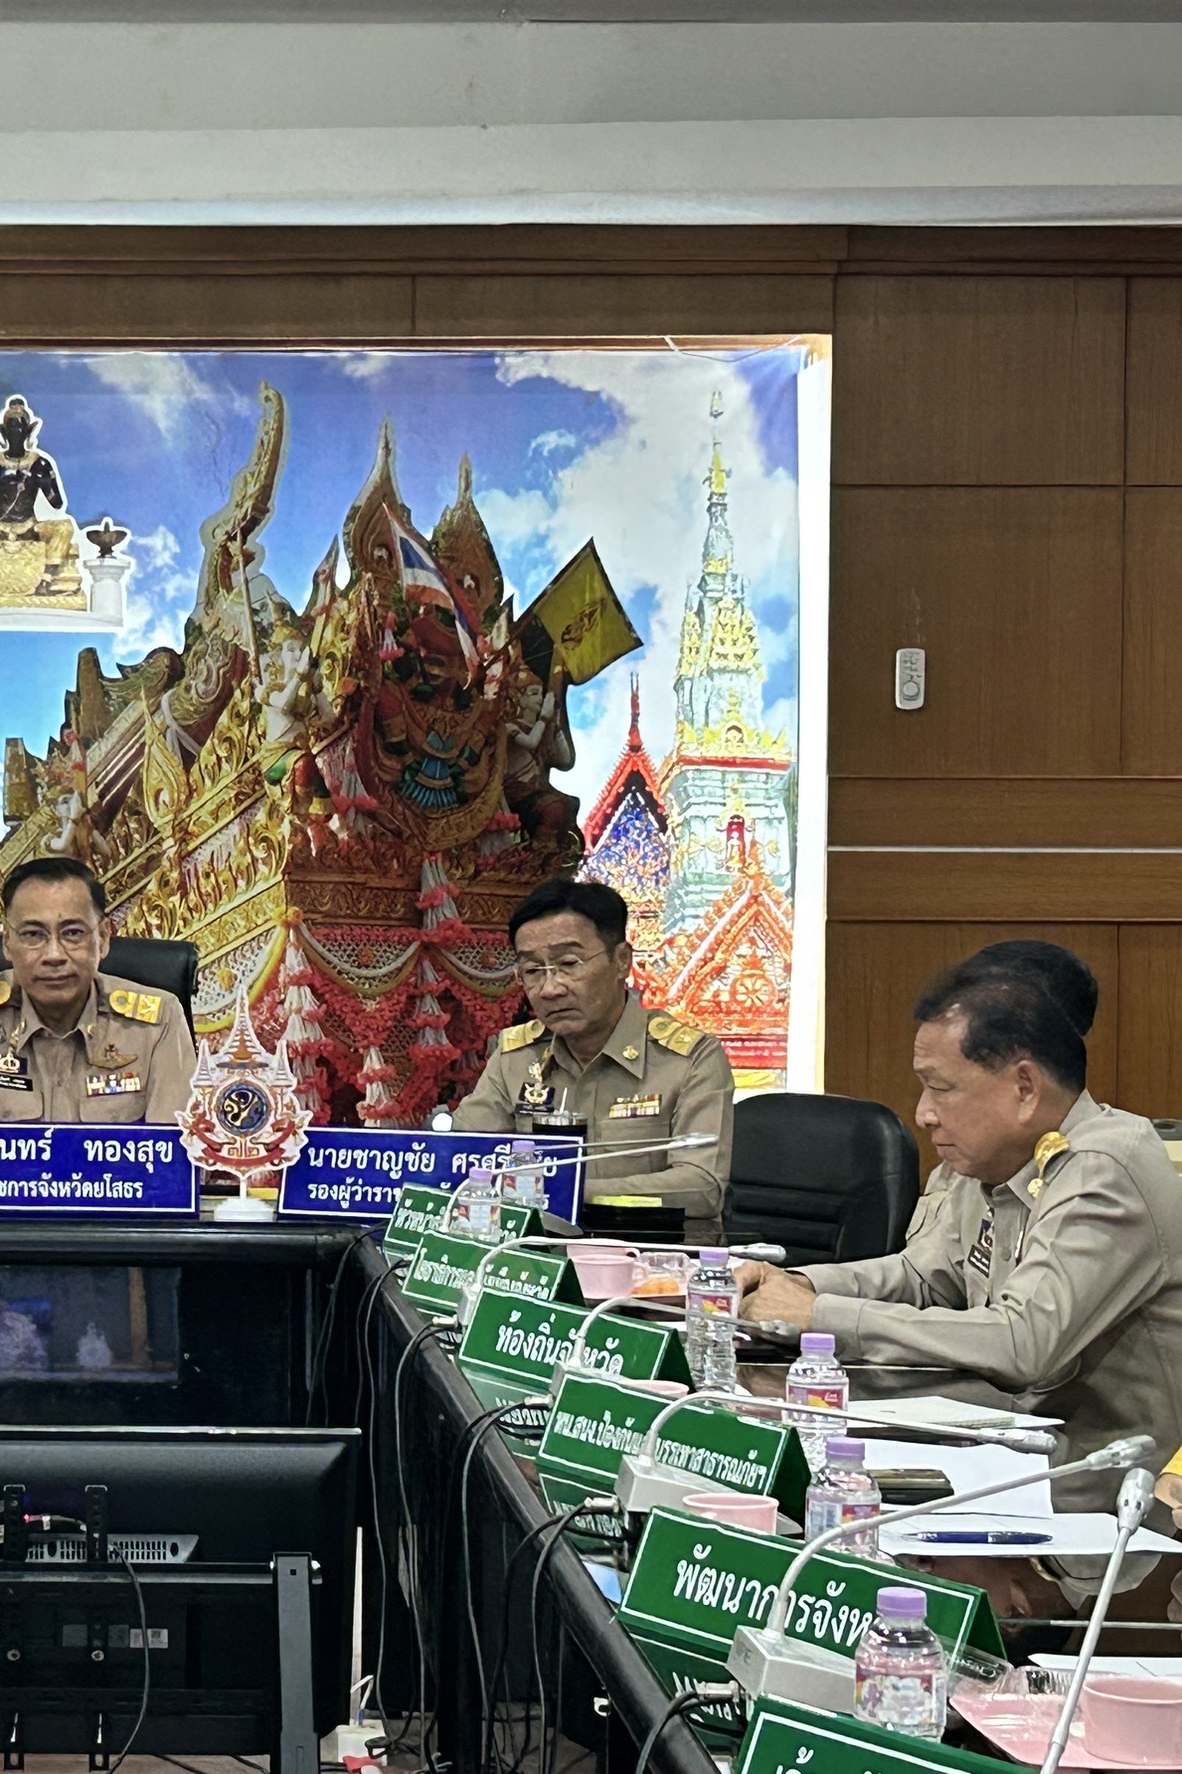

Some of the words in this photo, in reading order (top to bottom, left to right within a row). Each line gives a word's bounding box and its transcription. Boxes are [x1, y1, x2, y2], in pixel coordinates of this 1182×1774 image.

[83, 1137, 174, 1174] ทองสุข
[307, 1141, 436, 1181] นายชาญชัย
[494, 1309, 626, 1375] ท้องถิ่นจัหวัด
[672, 1543, 881, 1649] พัฒนาการจังห
